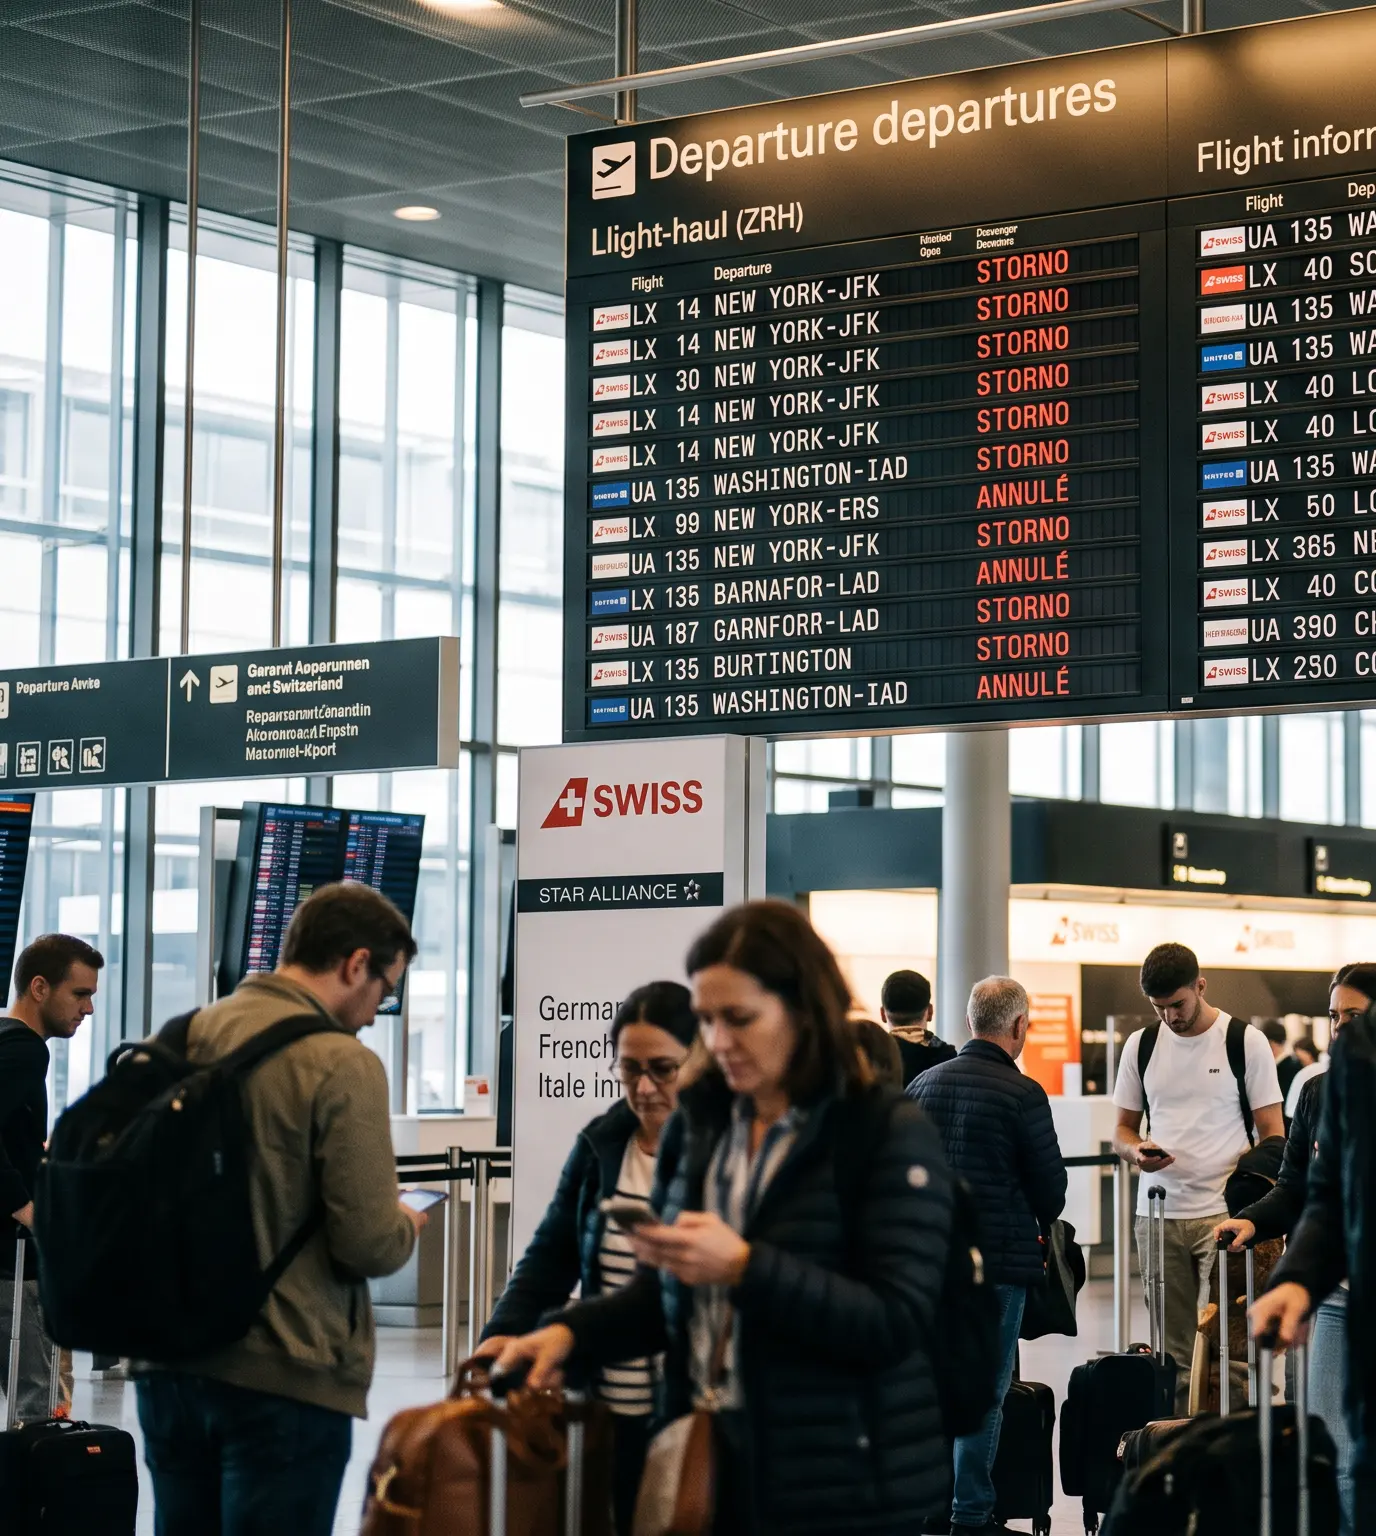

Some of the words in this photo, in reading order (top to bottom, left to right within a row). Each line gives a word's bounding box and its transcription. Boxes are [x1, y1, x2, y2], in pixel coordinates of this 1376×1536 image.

[650, 119, 857, 181] Departure
[872, 78, 1117, 148] departures
[1198, 136, 1283, 174] Flight
[1247, 194, 1283, 212] Flight
[737, 202, 803, 241] (ZRH)
[1249, 224, 1277, 249] UA
[1291, 216, 1332, 243] 135
[632, 275, 663, 292] Flight
[715, 264, 772, 281] Departure
[634, 302, 657, 325] LX
[677, 298, 700, 320] 14
[715, 290, 756, 316] NEW
[769, 274, 880, 308] YORK-JFK
[978, 250, 1068, 283] STORNO
[1250, 263, 1276, 288] LX
[1304, 256, 1332, 280] 40
[634, 338, 656, 360] LX
[677, 333, 700, 356] 14
[715, 326, 755, 351] NEW
[770, 311, 879, 344] YORK-JFK
[978, 288, 1068, 320] STORNO
[634, 373, 656, 395] LX
[676, 369, 699, 391] 30
[715, 362, 756, 387] NEW
[770, 348, 879, 381] YORK-JFK
[978, 326, 1068, 358] STORNO
[1250, 341, 1278, 366] UA
[1293, 335, 1333, 361] 135
[1251, 380, 1278, 405] LX
[1305, 374, 1333, 398] 40
[1251, 420, 1278, 444] LX
[1306, 414, 1334, 438] 40
[632, 481, 656, 503] UA
[666, 476, 699, 500] 135
[714, 456, 907, 495] WASHINGTON-IAD
[978, 440, 1068, 470] STORNO
[1251, 460, 1279, 483] UA
[1294, 454, 1334, 479] 135
[633, 516, 655, 538] LX
[676, 512, 699, 534] 99
[715, 507, 755, 531] NEW
[769, 496, 878, 526] YORK-ERS
[977, 474, 1068, 508] ANNULÉ
[1252, 498, 1279, 523] LX
[1308, 494, 1334, 517] 50
[632, 553, 655, 574] UA
[666, 549, 699, 572] 135
[715, 544, 754, 568] NEW
[769, 533, 879, 563] YORK-JFK
[978, 516, 1069, 546] STORNO
[1252, 538, 1279, 562] LX
[1293, 534, 1335, 558] 365
[632, 588, 654, 611] LX
[666, 585, 699, 608] 135
[715, 571, 879, 605] BARNAFOR-LAD
[977, 551, 1068, 584] ANNULÉ
[1253, 577, 1280, 602] LX
[1307, 574, 1335, 597] 40
[632, 625, 655, 647] UA
[666, 621, 699, 644] 187
[715, 609, 878, 641] GARNFORR-LAD
[978, 593, 1069, 622] STORNO
[1252, 618, 1280, 642] UA
[1293, 614, 1336, 639] 390
[632, 661, 653, 683] LX
[665, 658, 698, 680] 135
[715, 648, 851, 678] BURTINGTON
[978, 632, 1068, 660] STORNO
[1253, 657, 1280, 682] LX
[1294, 654, 1336, 679] 250
[631, 698, 654, 719] UA
[665, 694, 698, 717] 135
[713, 682, 907, 714] WASHINGTON-IAD
[978, 666, 1069, 699] ANNULÉ
[594, 780, 703, 818] SWISS
[539, 887, 585, 904] STAR
[588, 884, 677, 902] ALLIANCE
[1072, 922, 1119, 944] SWISS
[539, 1033, 615, 1059] French
[539, 1073, 585, 1098] Itale
